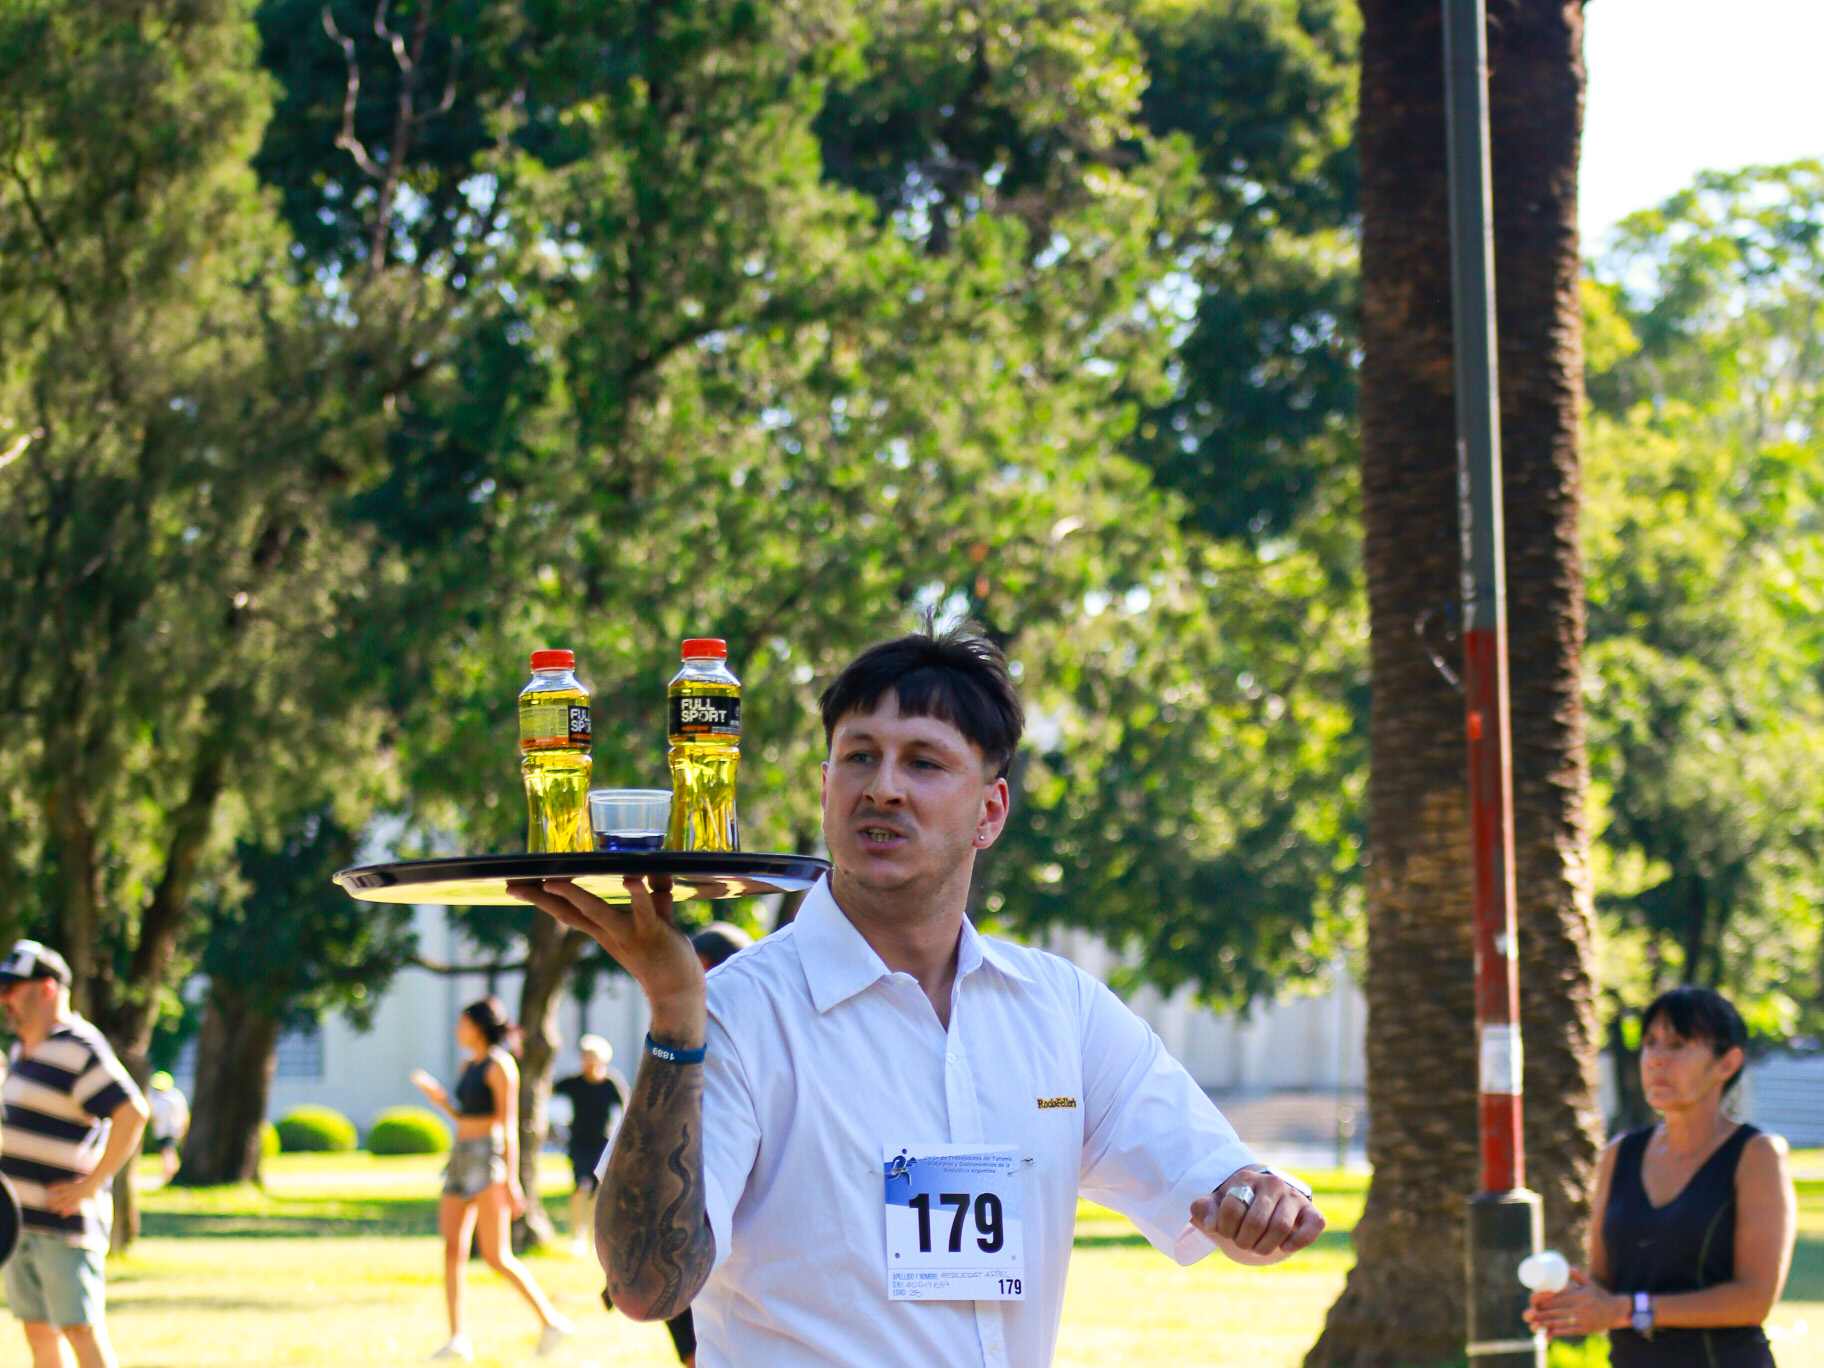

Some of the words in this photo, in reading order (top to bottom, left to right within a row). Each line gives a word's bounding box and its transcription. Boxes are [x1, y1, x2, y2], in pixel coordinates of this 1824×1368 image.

[681, 698, 715, 710] FULL
[681, 710, 728, 723] SPORT
[652, 1047, 675, 1061] 1889
[908, 1192, 1004, 1254] 179
[998, 1278, 1022, 1295] 179
